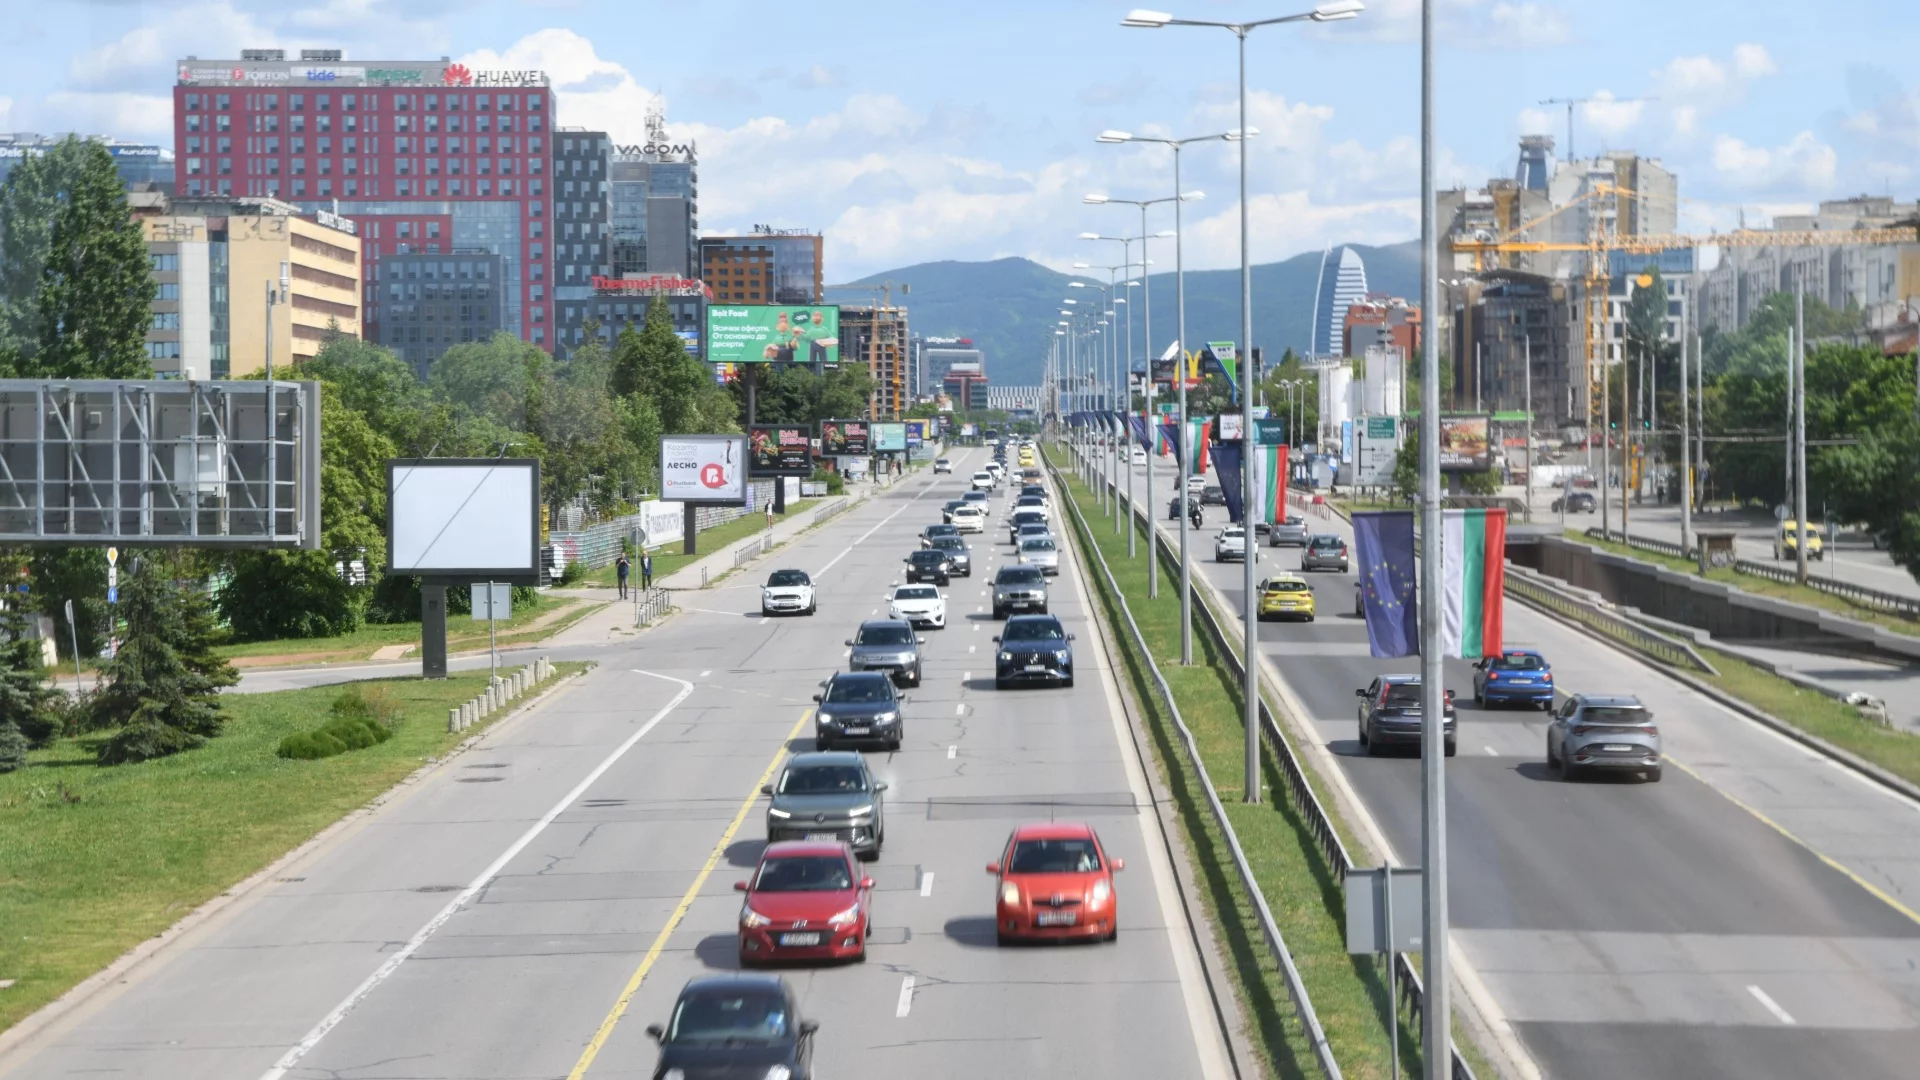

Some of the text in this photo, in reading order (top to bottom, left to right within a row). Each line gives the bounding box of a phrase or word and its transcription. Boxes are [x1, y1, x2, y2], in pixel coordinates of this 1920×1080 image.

[245, 71, 289, 80] FORTON
[307, 69, 336, 81] tide
[477, 70, 545, 82] HUAWEI
[712, 309, 748, 317] Bolt Food
